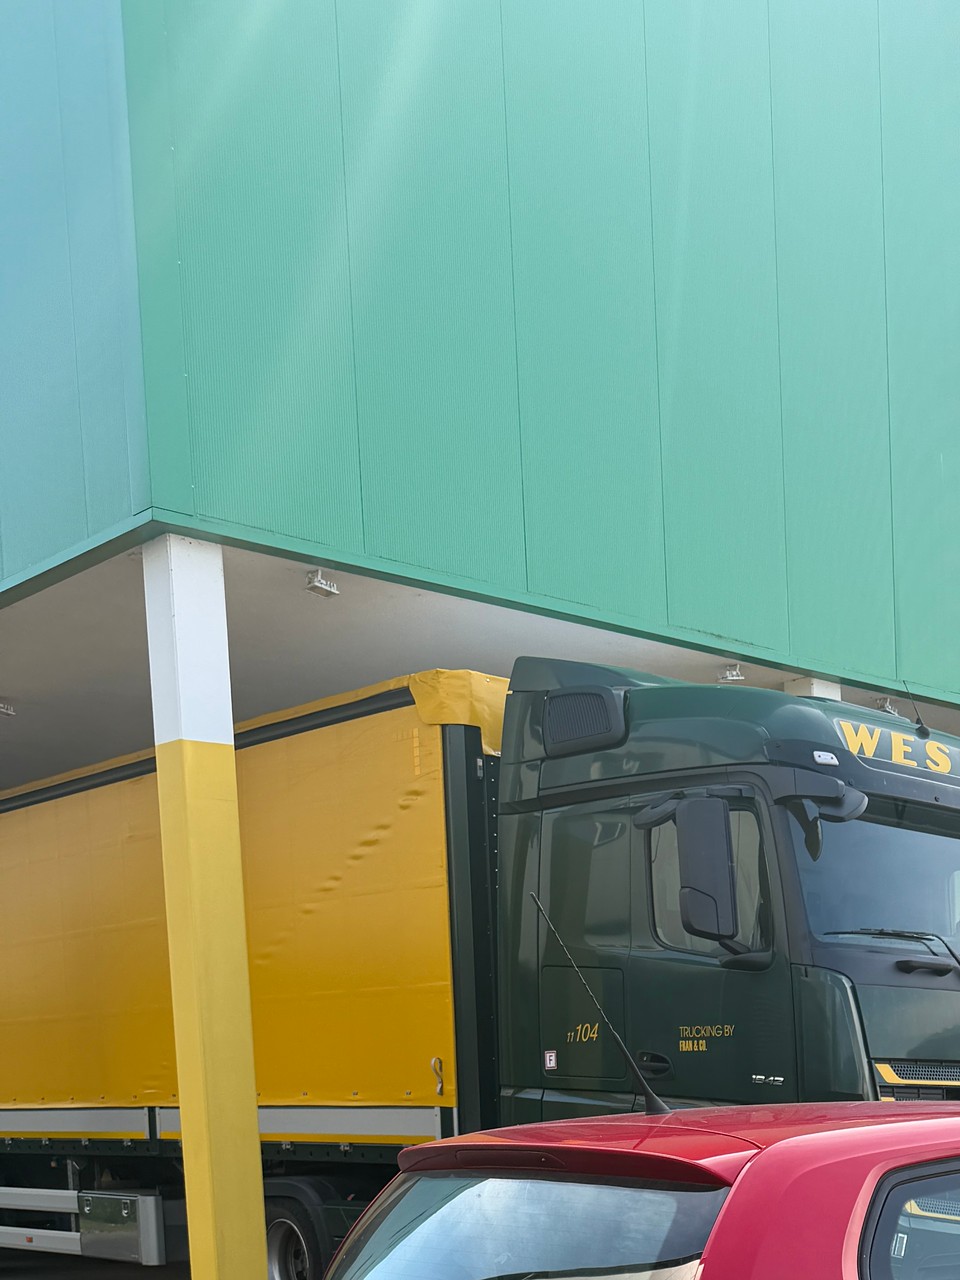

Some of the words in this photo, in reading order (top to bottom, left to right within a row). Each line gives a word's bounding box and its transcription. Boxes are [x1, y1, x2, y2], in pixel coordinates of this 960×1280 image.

[679, 1025, 723, 1038] TRUCKING
[724, 1025, 735, 1037] BY
[694, 1040, 699, 1051] &
